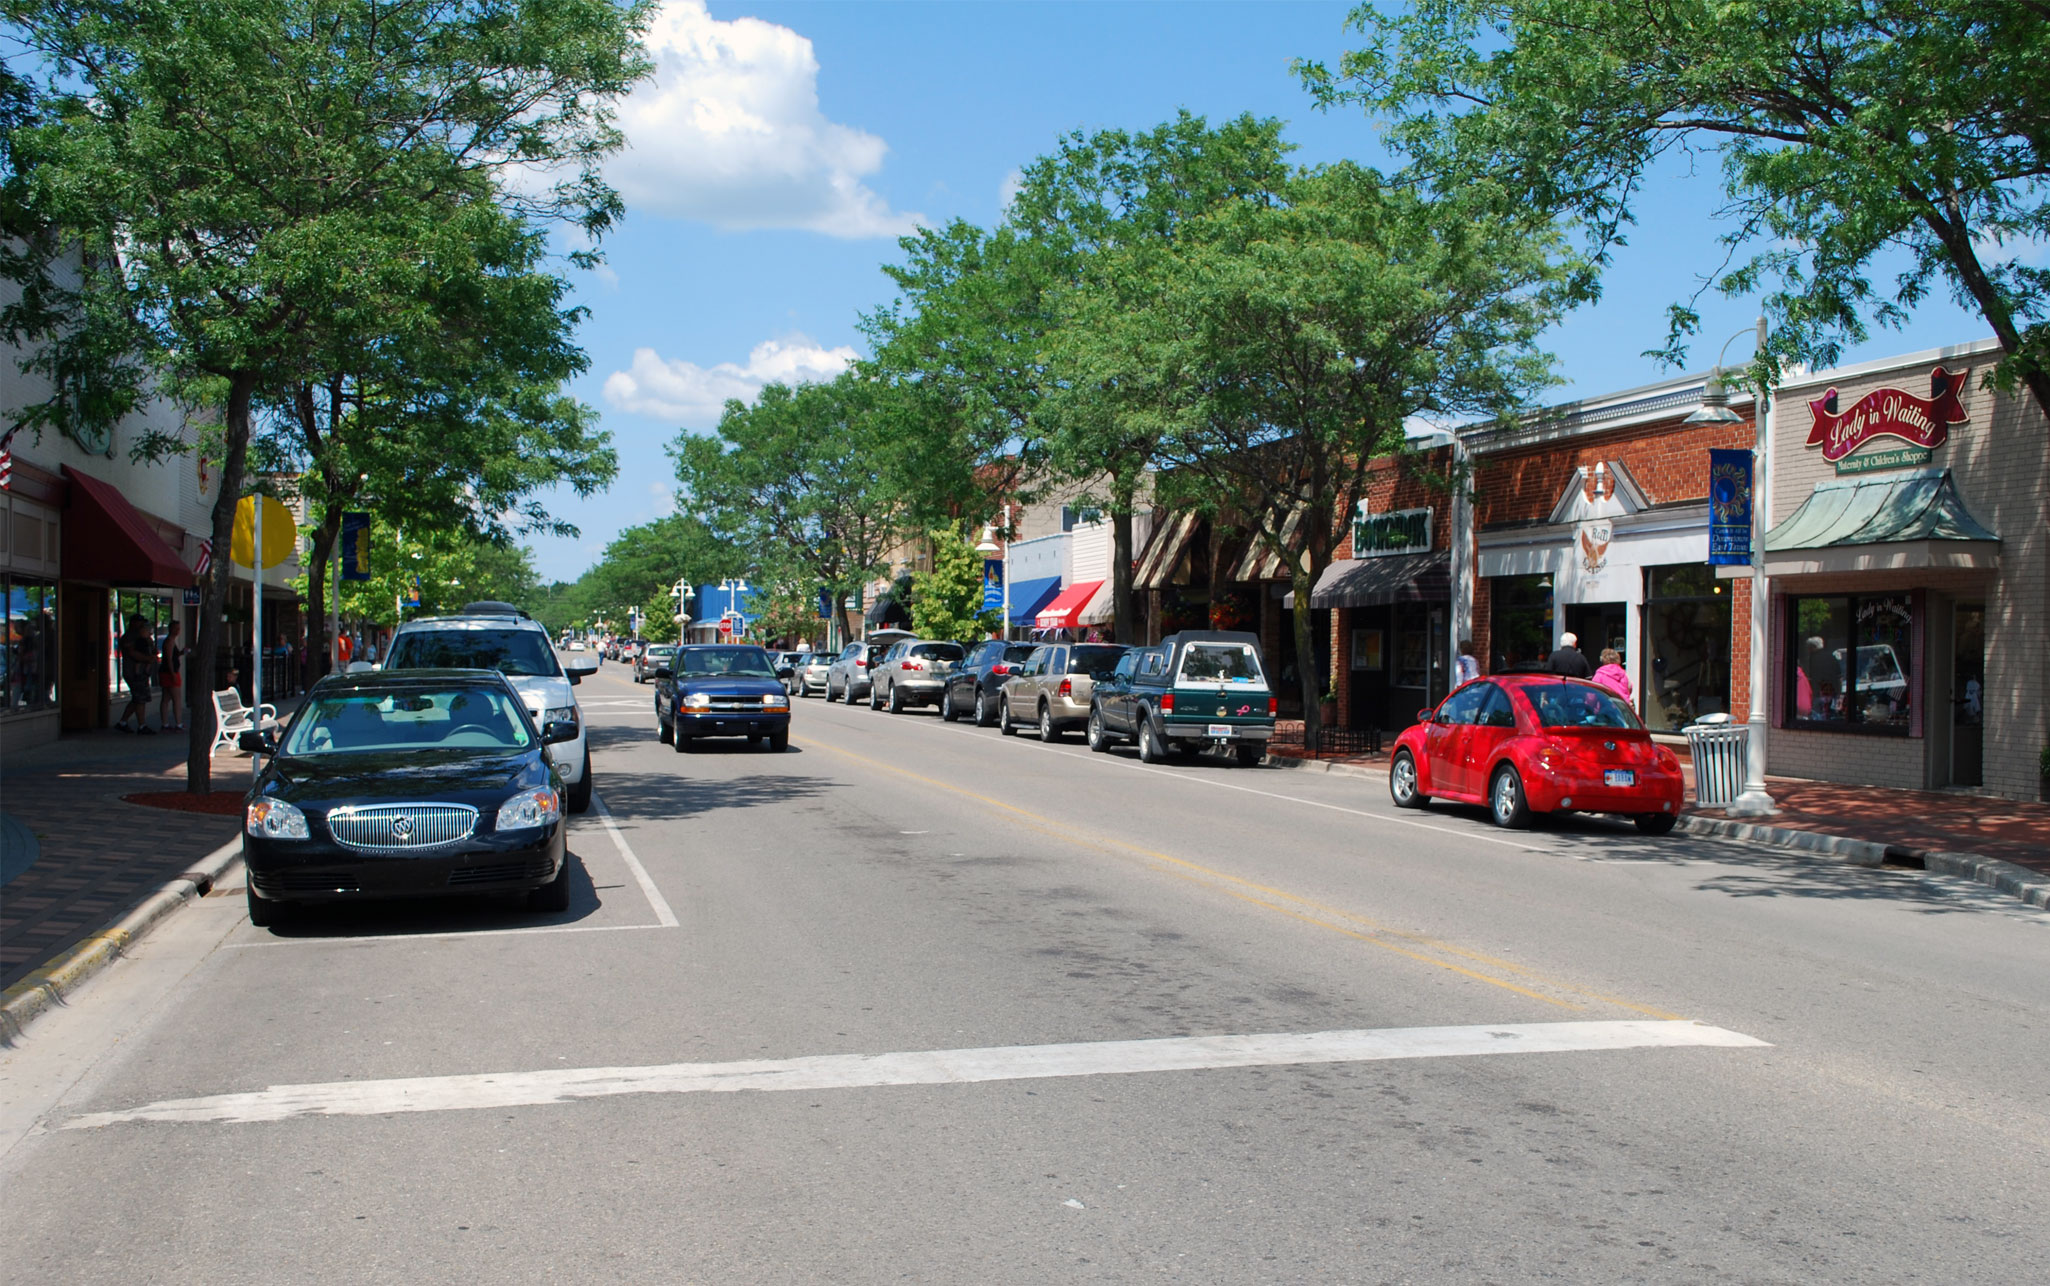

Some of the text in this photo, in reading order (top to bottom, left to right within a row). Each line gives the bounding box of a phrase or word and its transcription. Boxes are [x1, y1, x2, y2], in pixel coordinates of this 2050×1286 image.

[1830, 395, 1936, 453] Lady in Waiting
[1863, 457, 1870, 467] &
[1871, 454, 1900, 467] Children's
[1901, 450, 1928, 465] Shoppe
